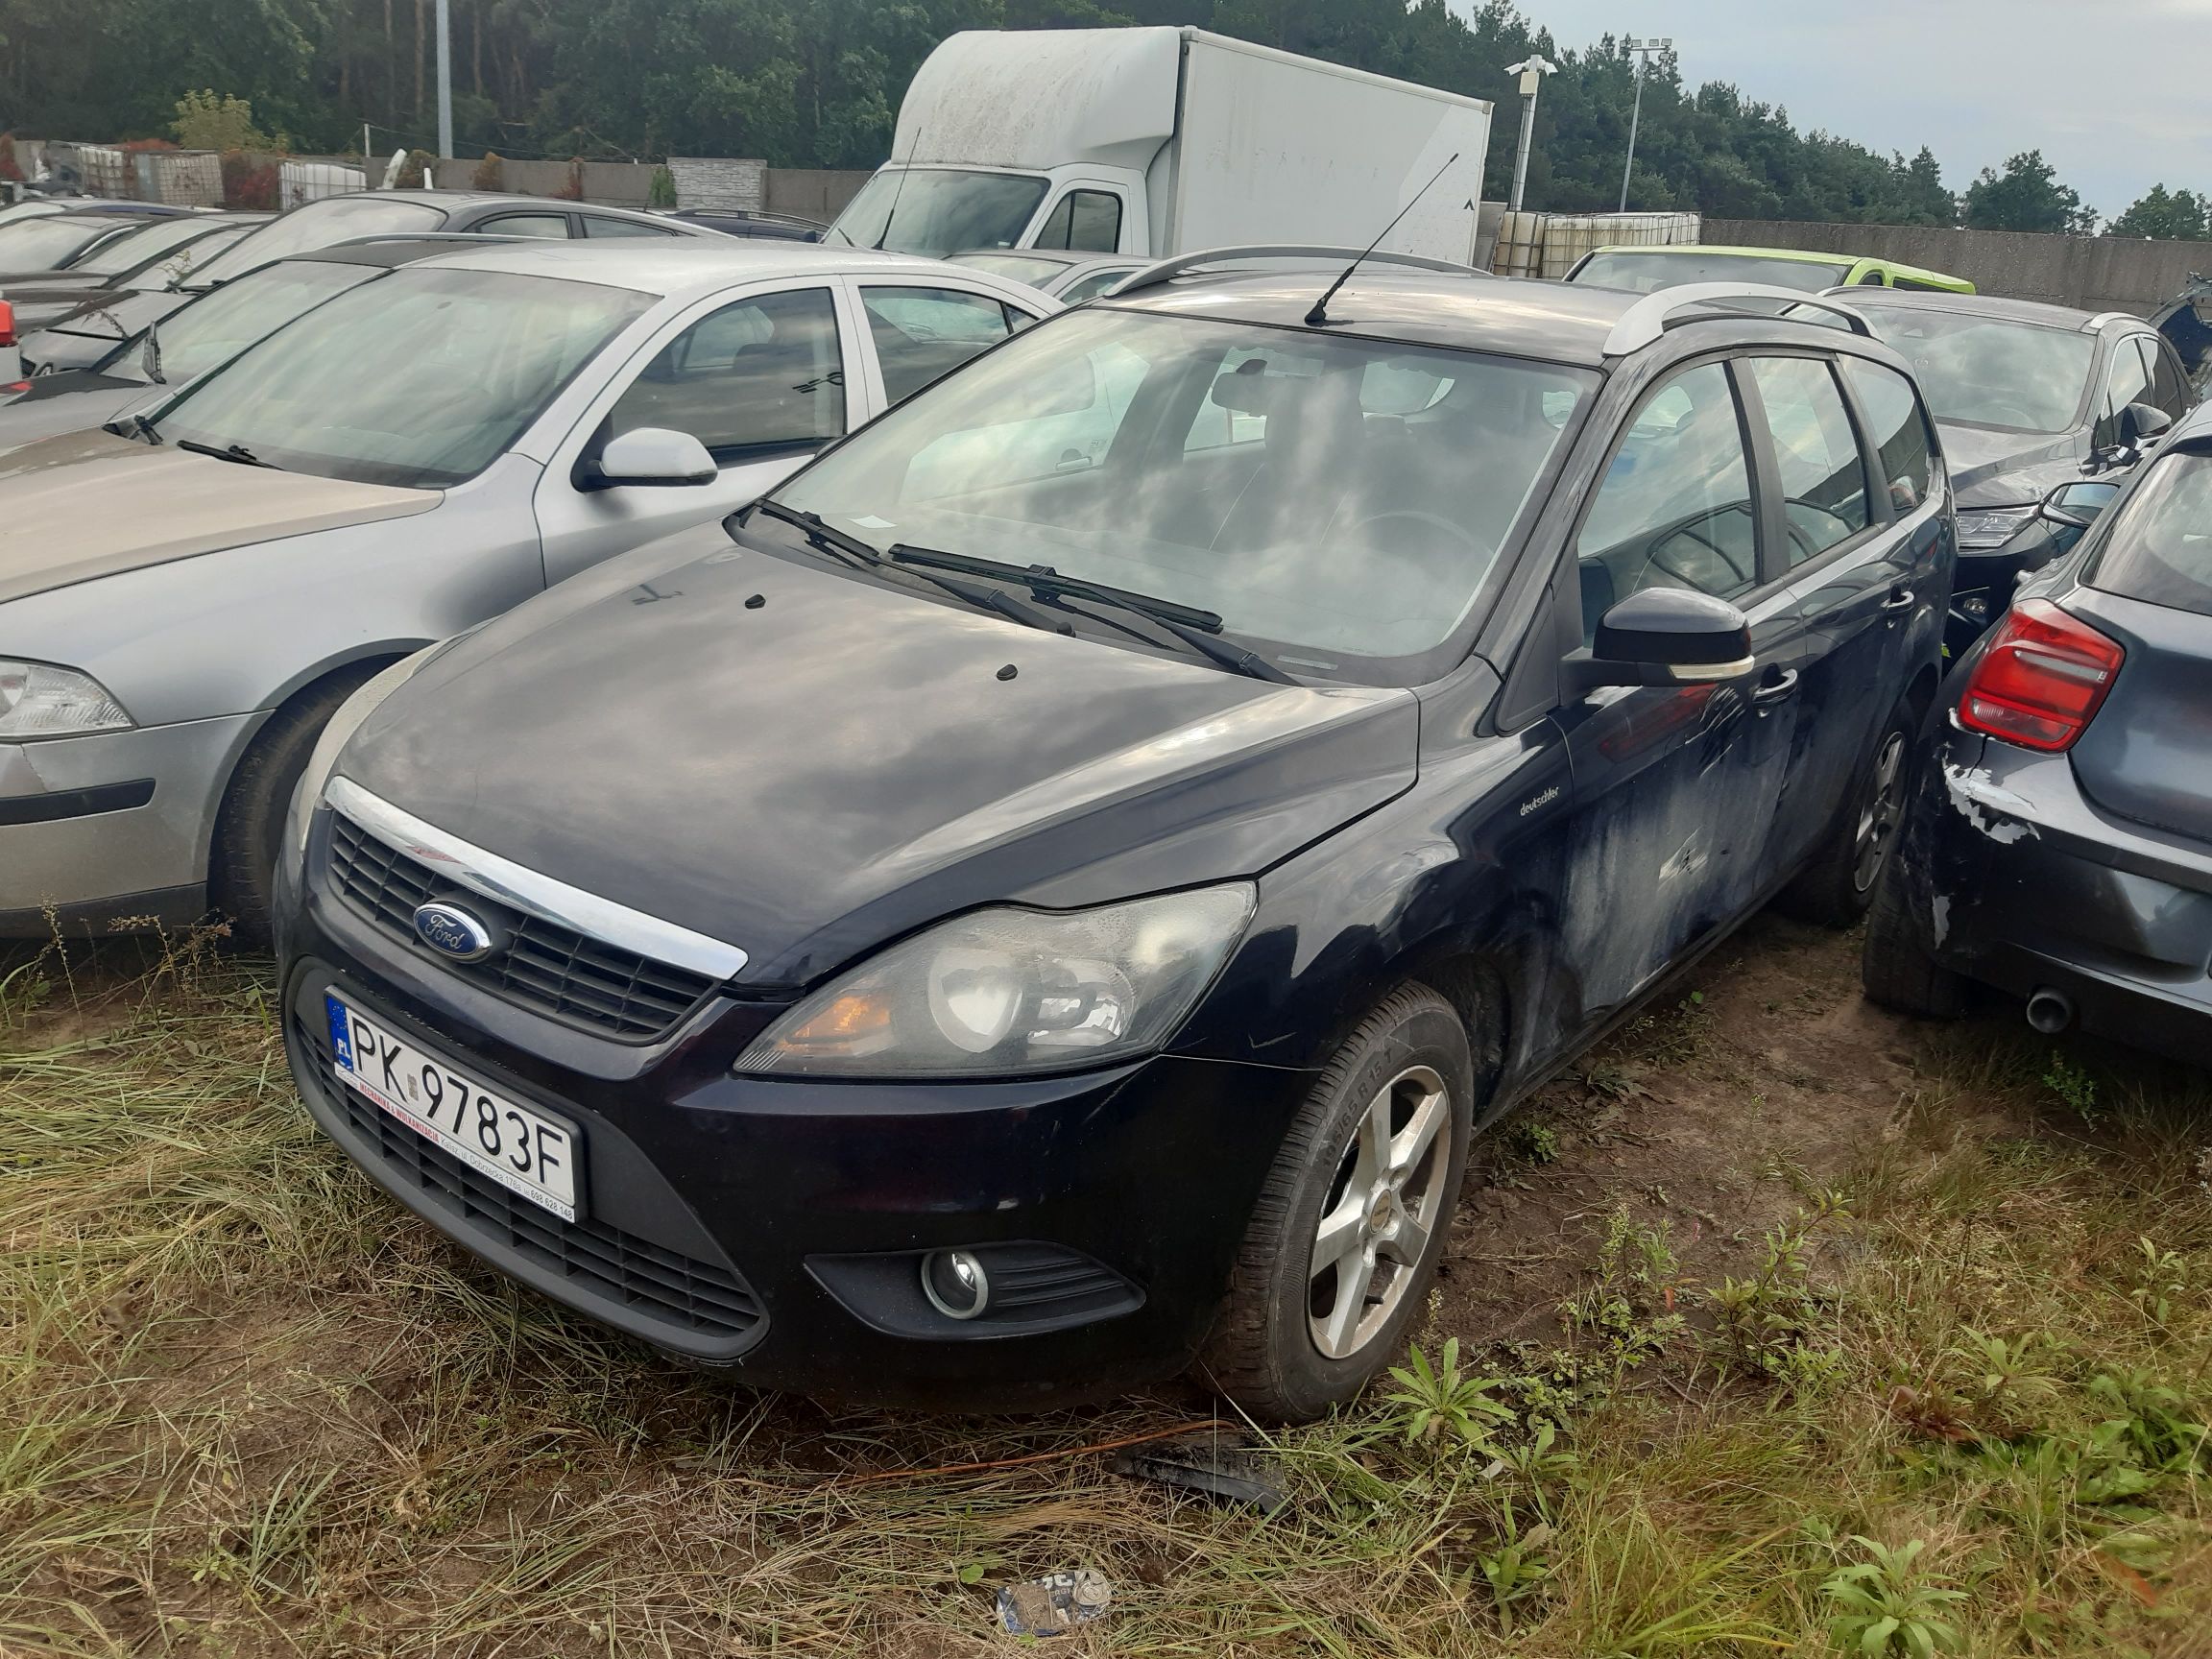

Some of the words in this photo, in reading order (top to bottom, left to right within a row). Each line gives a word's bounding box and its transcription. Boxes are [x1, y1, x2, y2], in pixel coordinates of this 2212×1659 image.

[425, 914, 466, 950] Ford
[337, 1038, 351, 1060] PL
[351, 1016, 409, 1103] PK
[421, 1064, 563, 1185] 9783F
[359, 1082, 391, 1112] MECHANIKA
